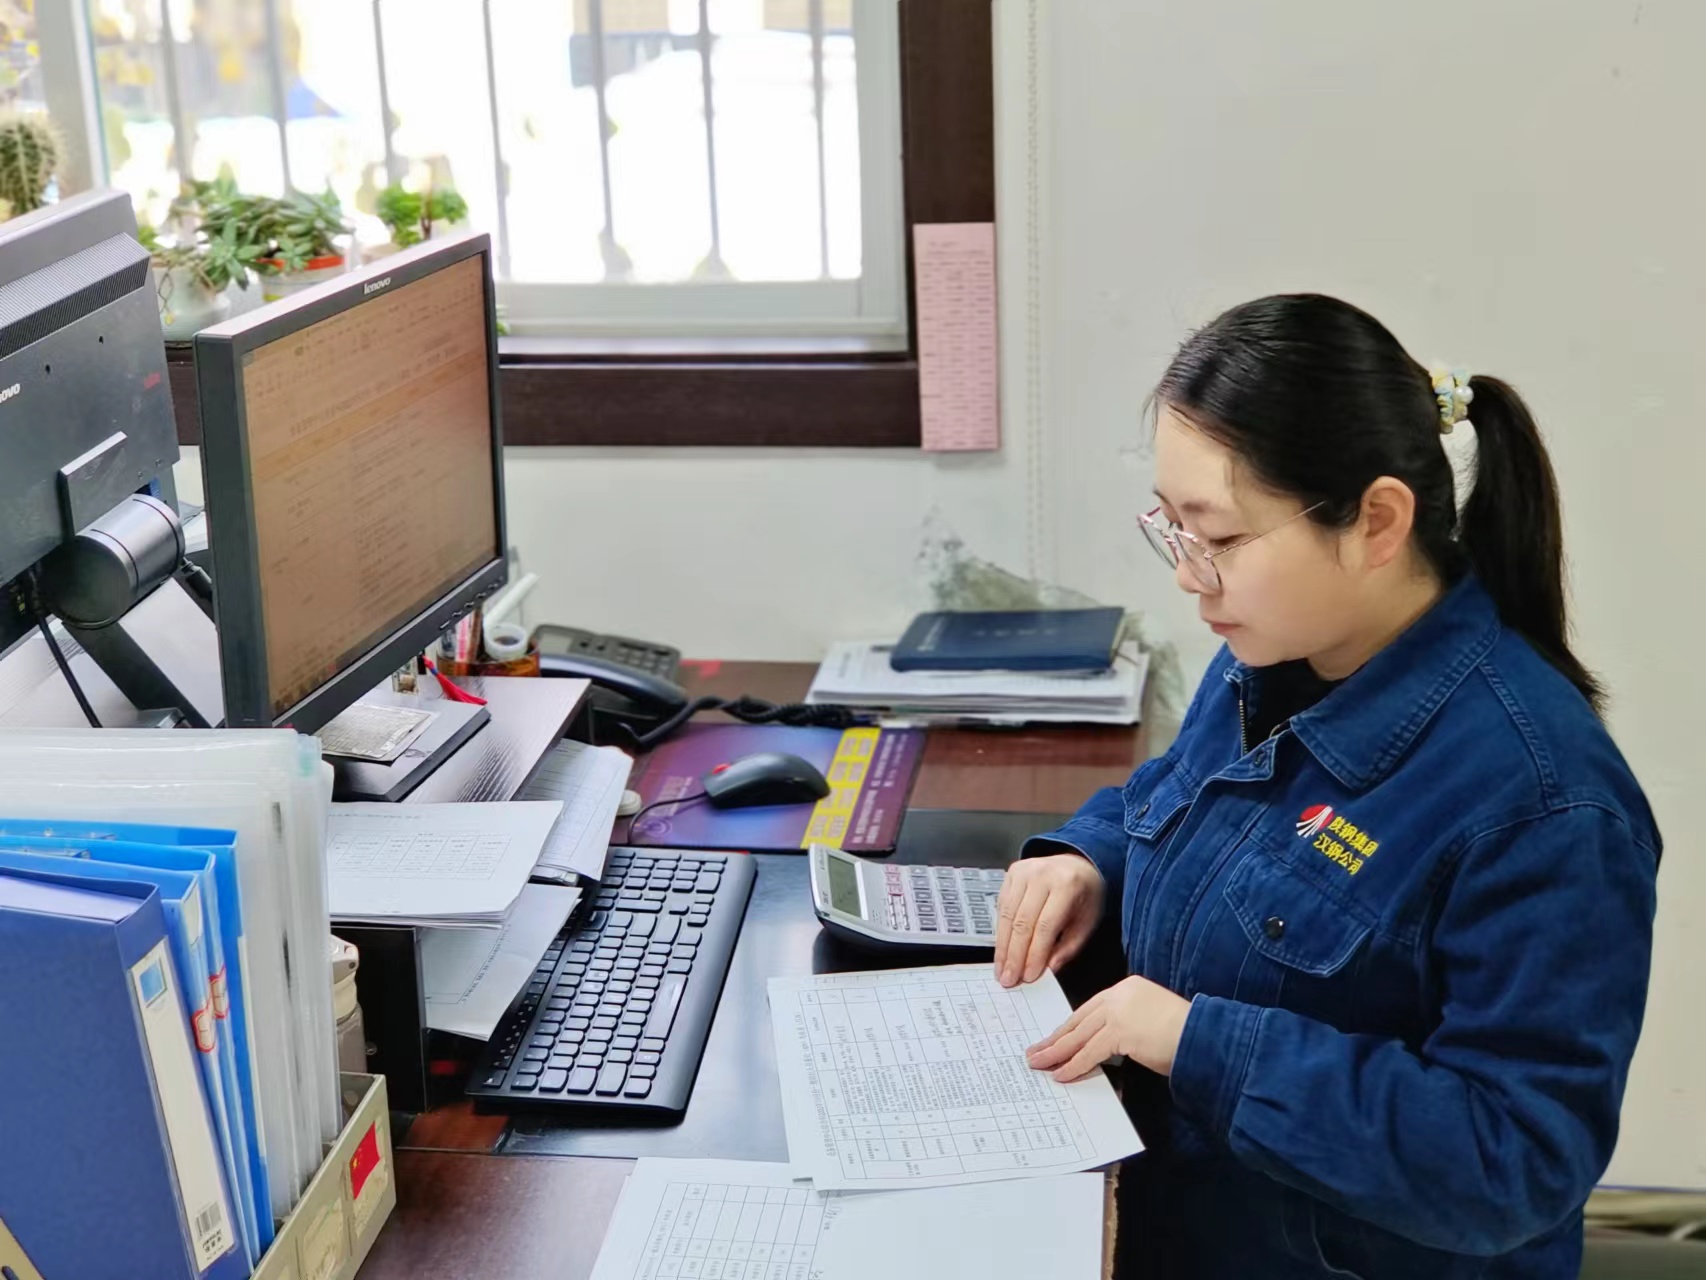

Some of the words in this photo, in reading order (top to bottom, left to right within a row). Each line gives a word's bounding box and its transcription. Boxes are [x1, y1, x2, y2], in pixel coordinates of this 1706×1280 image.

[363, 276, 392, 295] lenovo
[1313, 833, 1364, 875] 汉钢公司
